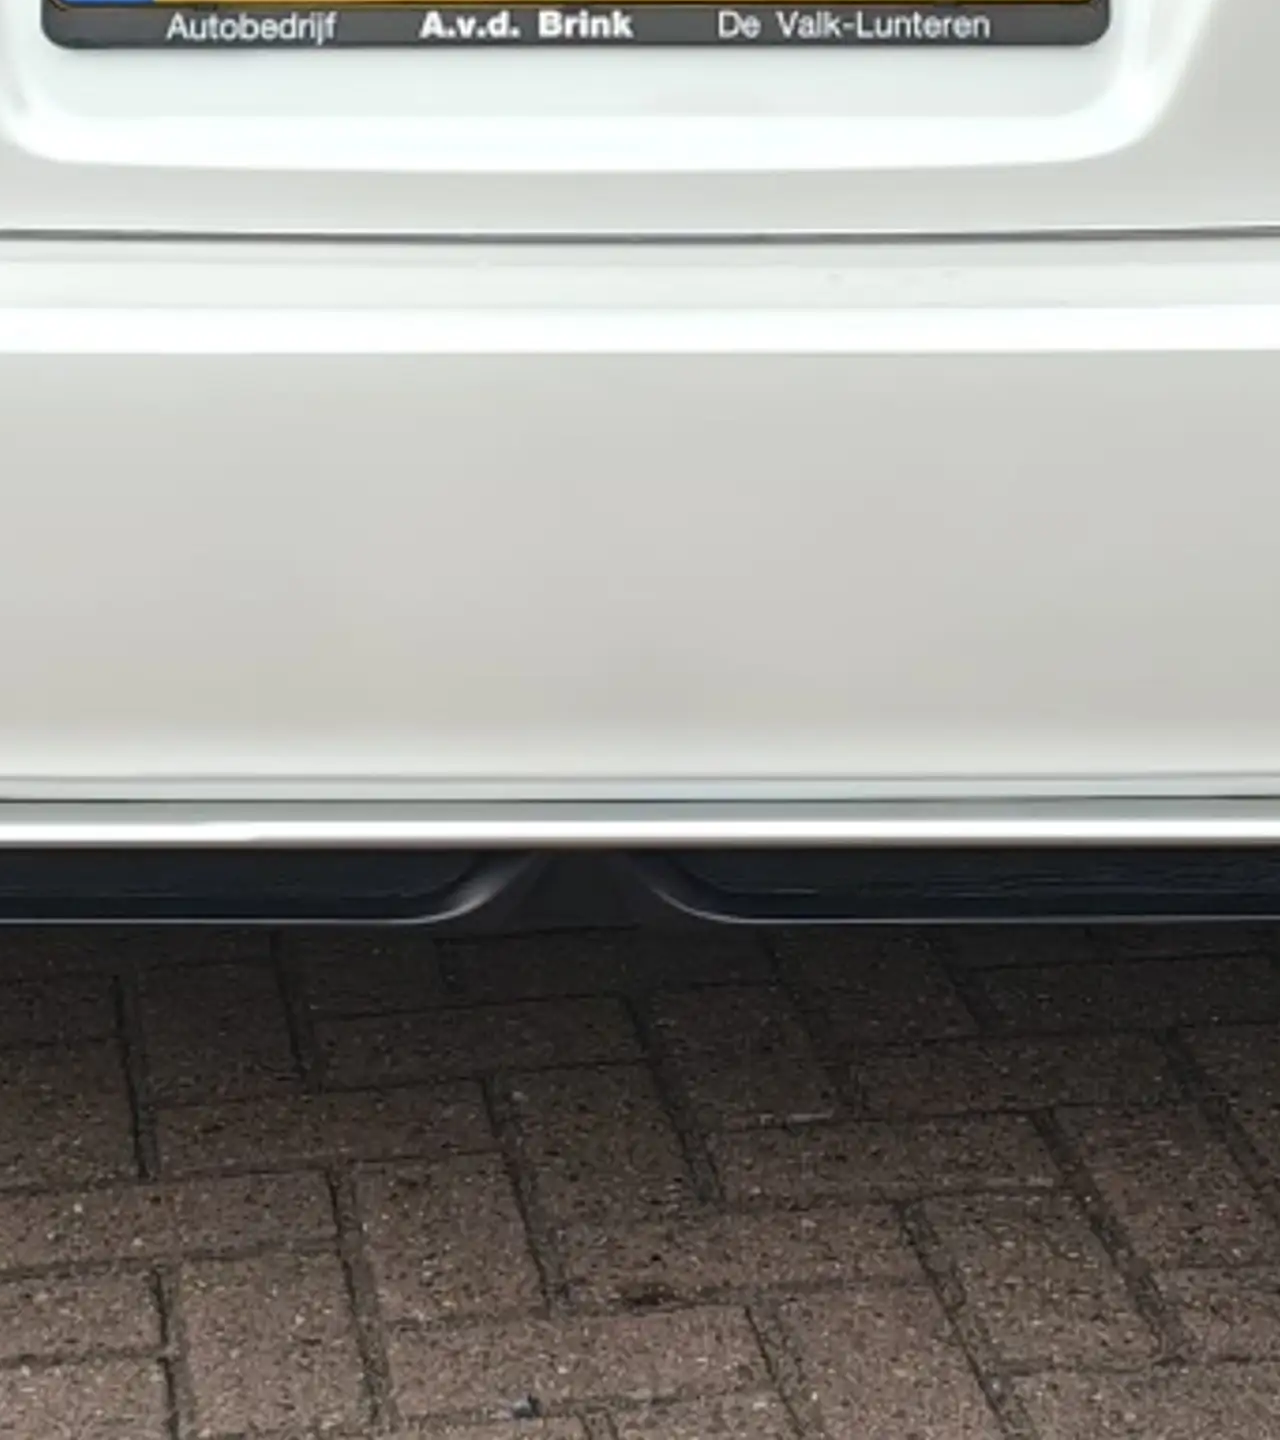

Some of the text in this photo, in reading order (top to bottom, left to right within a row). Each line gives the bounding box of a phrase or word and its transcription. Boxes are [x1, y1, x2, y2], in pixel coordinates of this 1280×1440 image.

[166, 10, 991, 45] Autobedrijf A.v.d. Brink De Valk-Lunteren
